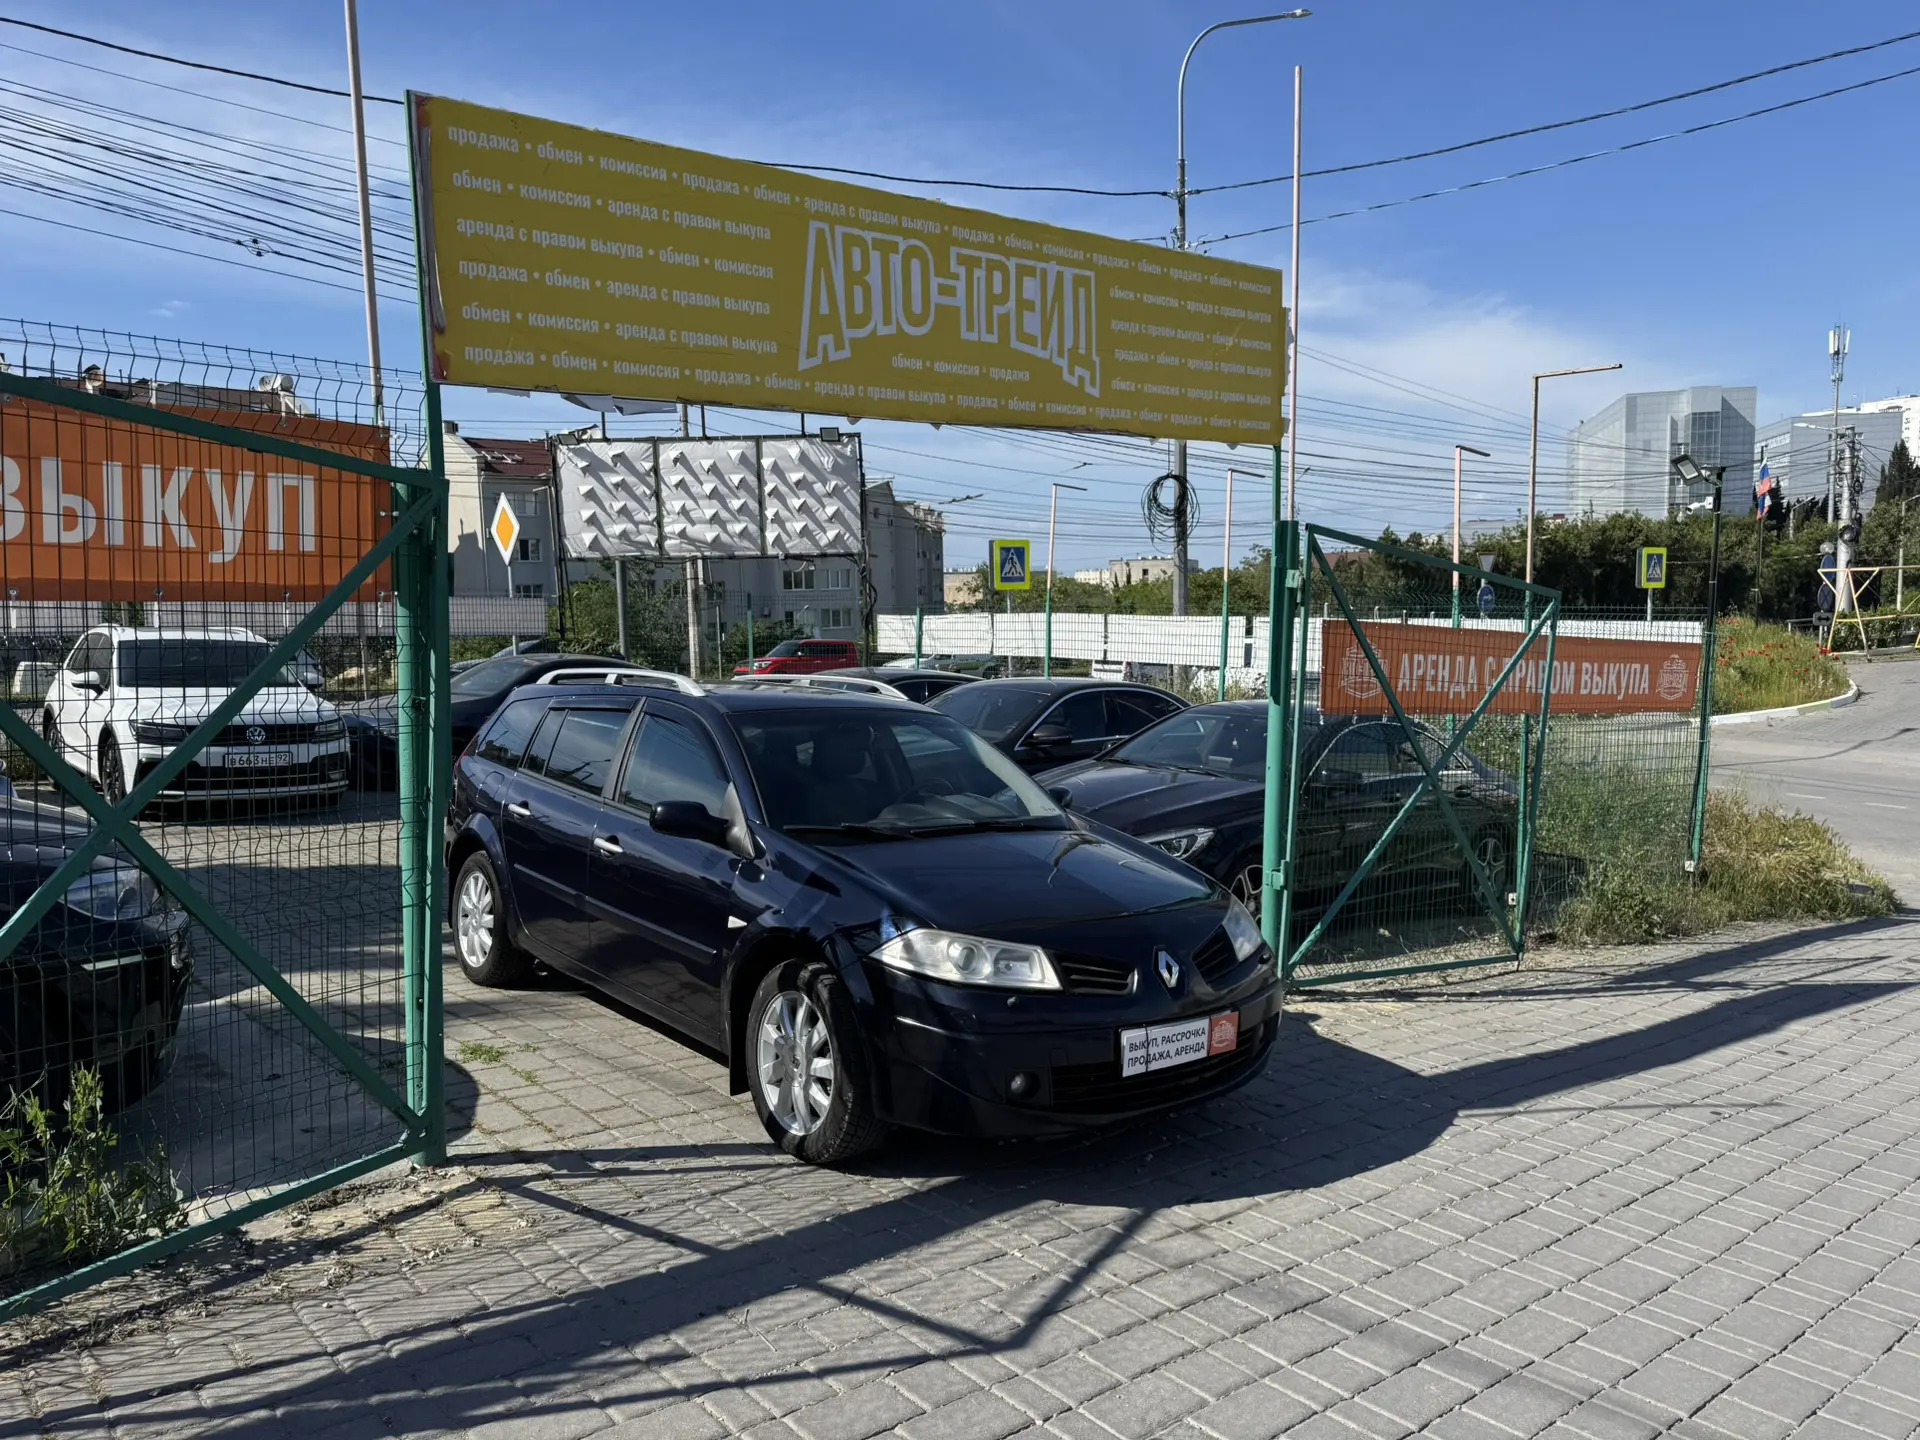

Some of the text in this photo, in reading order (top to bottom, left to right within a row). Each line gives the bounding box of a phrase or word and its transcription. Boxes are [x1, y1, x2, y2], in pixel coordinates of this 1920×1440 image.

[447, 125, 520, 154] продажа
[536, 141, 584, 166] обмен
[599, 156, 668, 182] комиссия
[682, 172, 741, 196] продажа
[753, 183, 792, 206] обмен
[803, 196, 847, 216] аренда
[848, 206, 856, 218] с
[858, 207, 899, 226] правом
[901, 215, 942, 234] выкупа
[951, 225, 995, 244] продажа
[1004, 233, 1033, 251] обмен
[1042, 243, 1085, 261] комиссия
[452, 169, 772, 241] обмен комиссия аренда с правом выкупа
[456, 218, 775, 280] аренда с правом выкупа обмен комиссия
[458, 260, 771, 316] продажа обмен аренда с правом выкупа
[461, 301, 778, 355] обмен комиссия аренда с правом выкупа
[464, 346, 535, 367] продажа
[551, 350, 598, 372] обмен
[613, 360, 680, 380] комиссия
[694, 368, 752, 387] продажа
[764, 372, 802, 391] обмен
[814, 381, 855, 399] аренда
[857, 385, 865, 398] с
[866, 386, 907, 401] правом
[907, 390, 947, 406] выкупа
[957, 394, 999, 409] продажа
[1008, 396, 1037, 412] обмен
[1044, 402, 1087, 416] комиссия
[890, 352, 1031, 382] обмен комиссия продажа
[1398, 653, 1478, 699] АРЕНДА
[1580, 661, 1650, 700] ВЫКУПА
[1127, 1041, 1206, 1069] ПРОДАЖА, АРЕНДА
[1161, 1026, 1206, 1046] РАССРОЧКА
